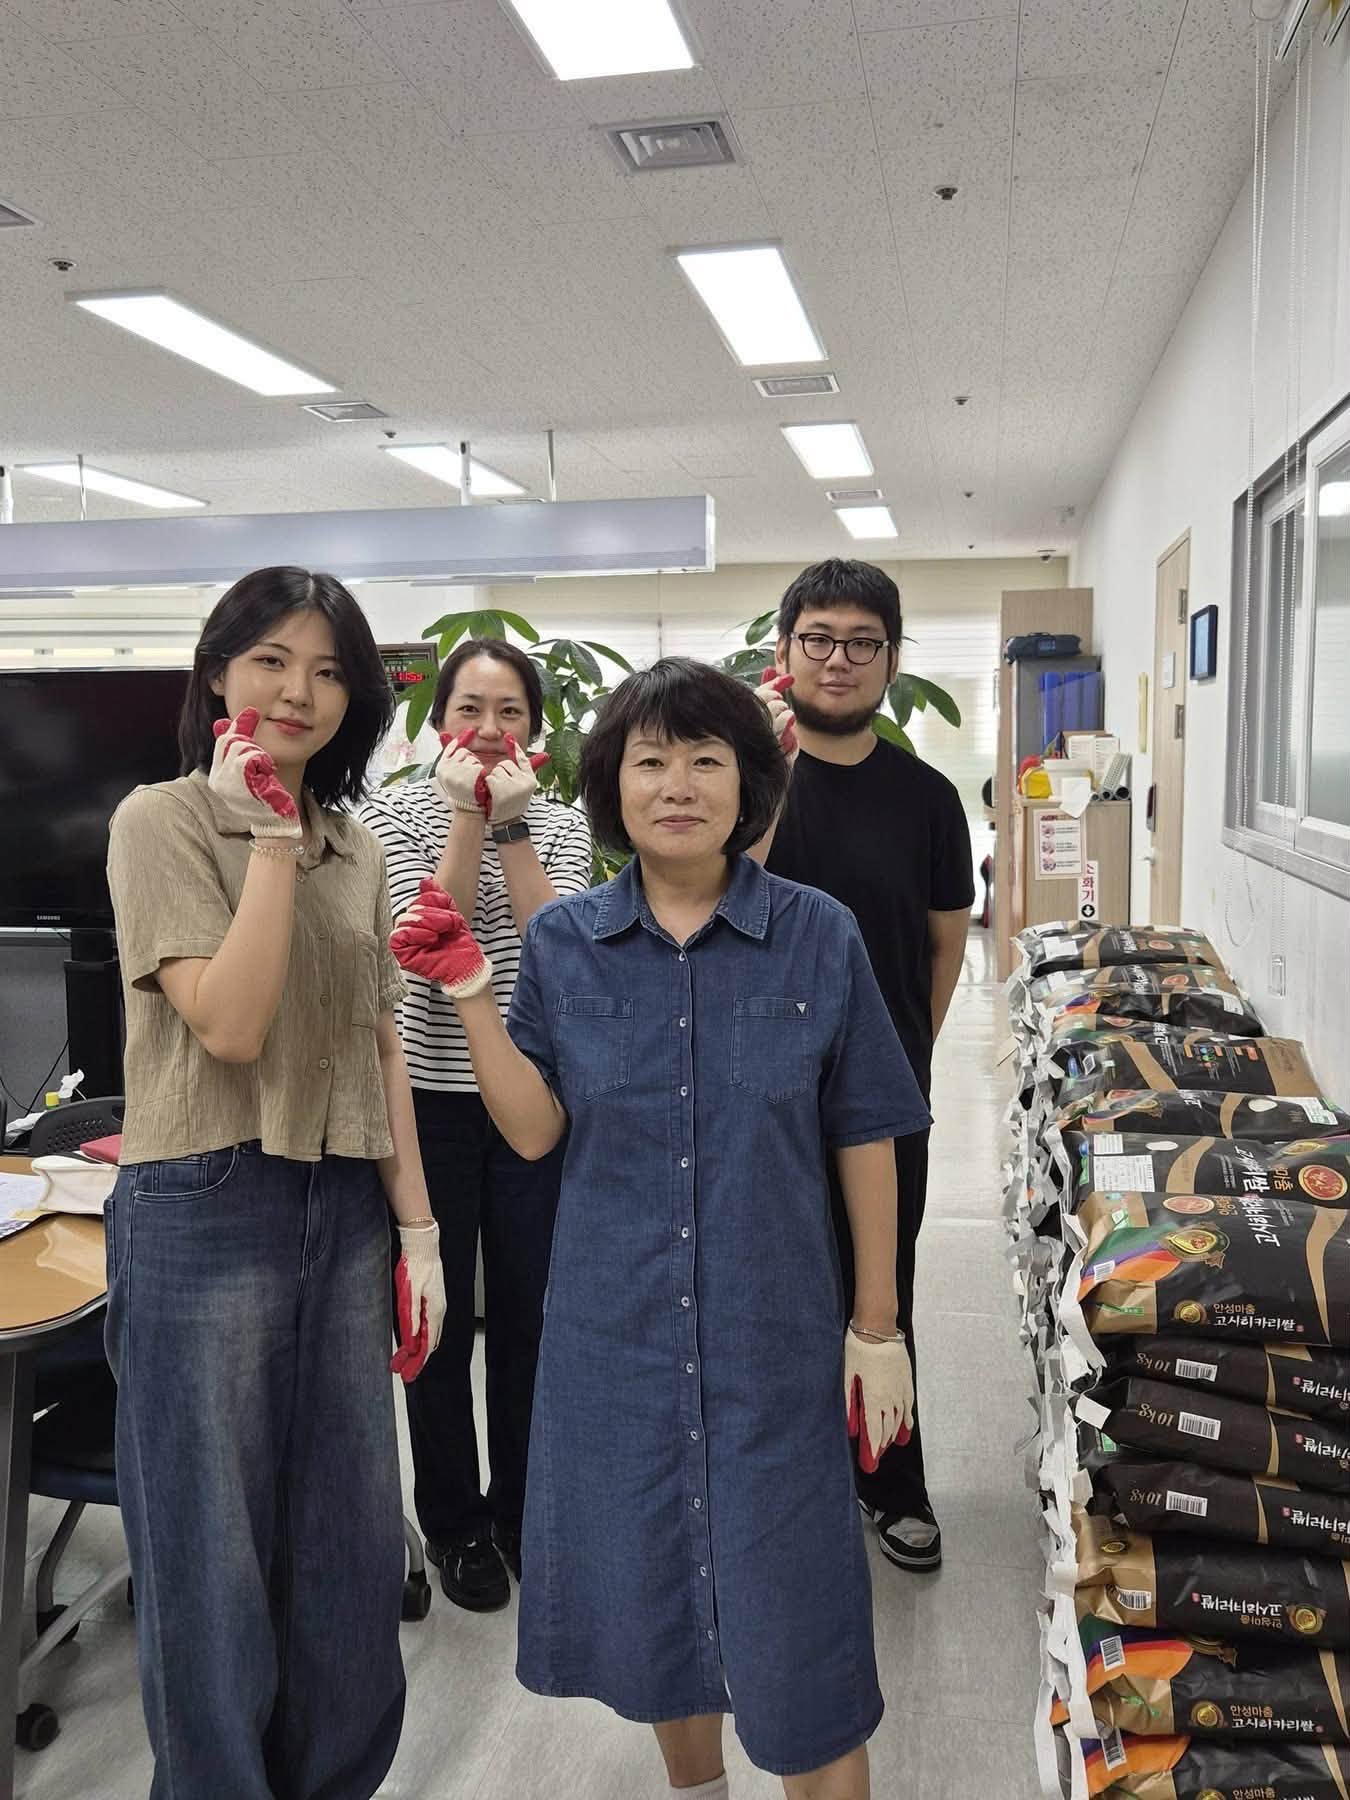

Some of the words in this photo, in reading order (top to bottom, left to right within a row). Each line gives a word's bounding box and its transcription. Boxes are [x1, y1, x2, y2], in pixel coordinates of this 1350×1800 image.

[1213, 1315, 1297, 1332] 고시히카리쌀
[1201, 1594, 1282, 1616] 고시히카리쌀
[1231, 1718, 1315, 1733] 고시히카리쌀
